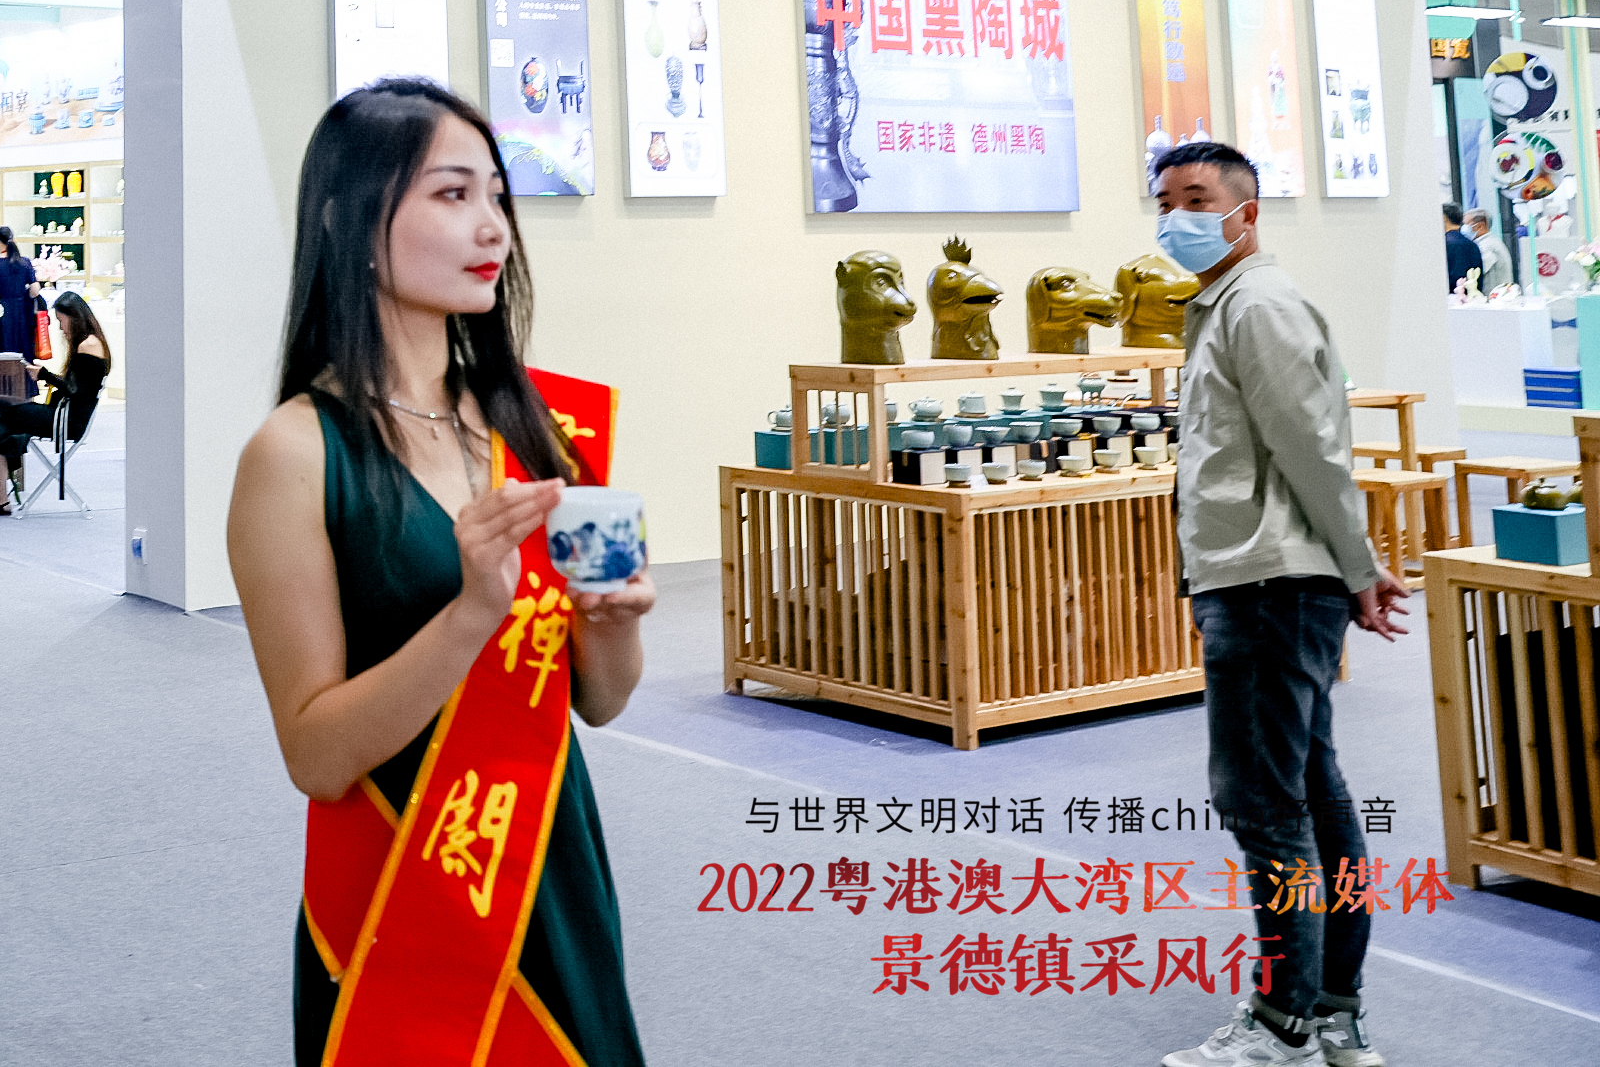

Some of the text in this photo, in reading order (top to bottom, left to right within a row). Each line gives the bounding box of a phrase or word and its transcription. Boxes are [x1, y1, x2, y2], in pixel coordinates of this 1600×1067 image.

[877, 120, 1046, 155] 国家非遗 德州黑陶
